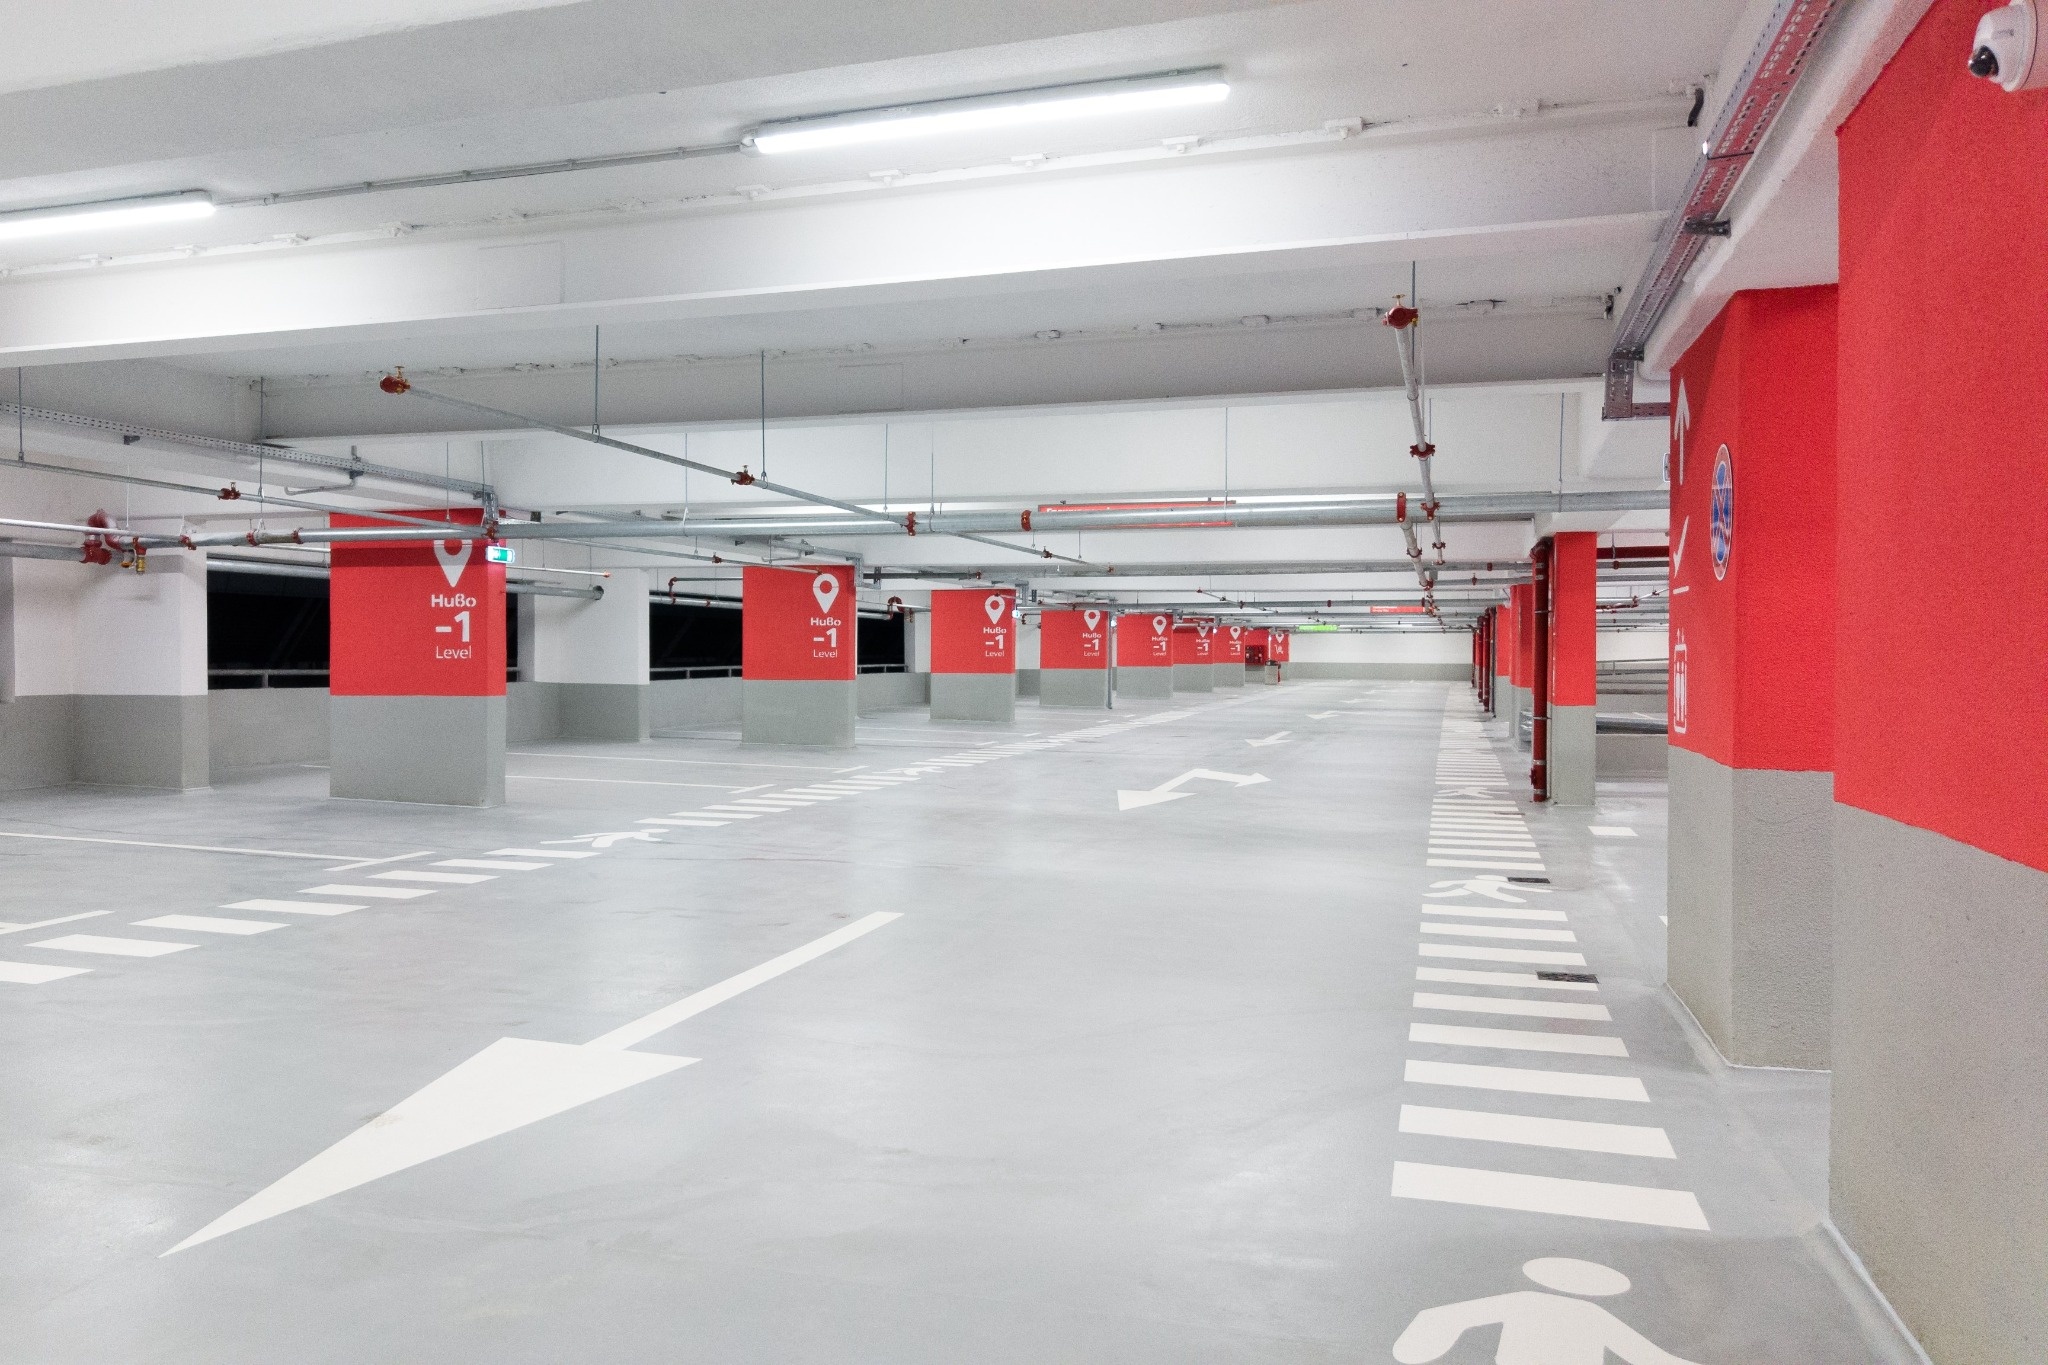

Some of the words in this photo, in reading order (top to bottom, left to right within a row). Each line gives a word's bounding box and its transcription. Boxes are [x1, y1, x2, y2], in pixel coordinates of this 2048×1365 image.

[435, 610, 470, 643] -1
[813, 627, 837, 648] -1
[985, 635, 1004, 649] -1
[1084, 639, 1100, 651] -1
[1153, 641, 1166, 651] -1
[1197, 643, 1209, 652] -1
[1230, 644, 1241, 652] -1
[436, 645, 472, 659] Level
[813, 649, 838, 658] Level
